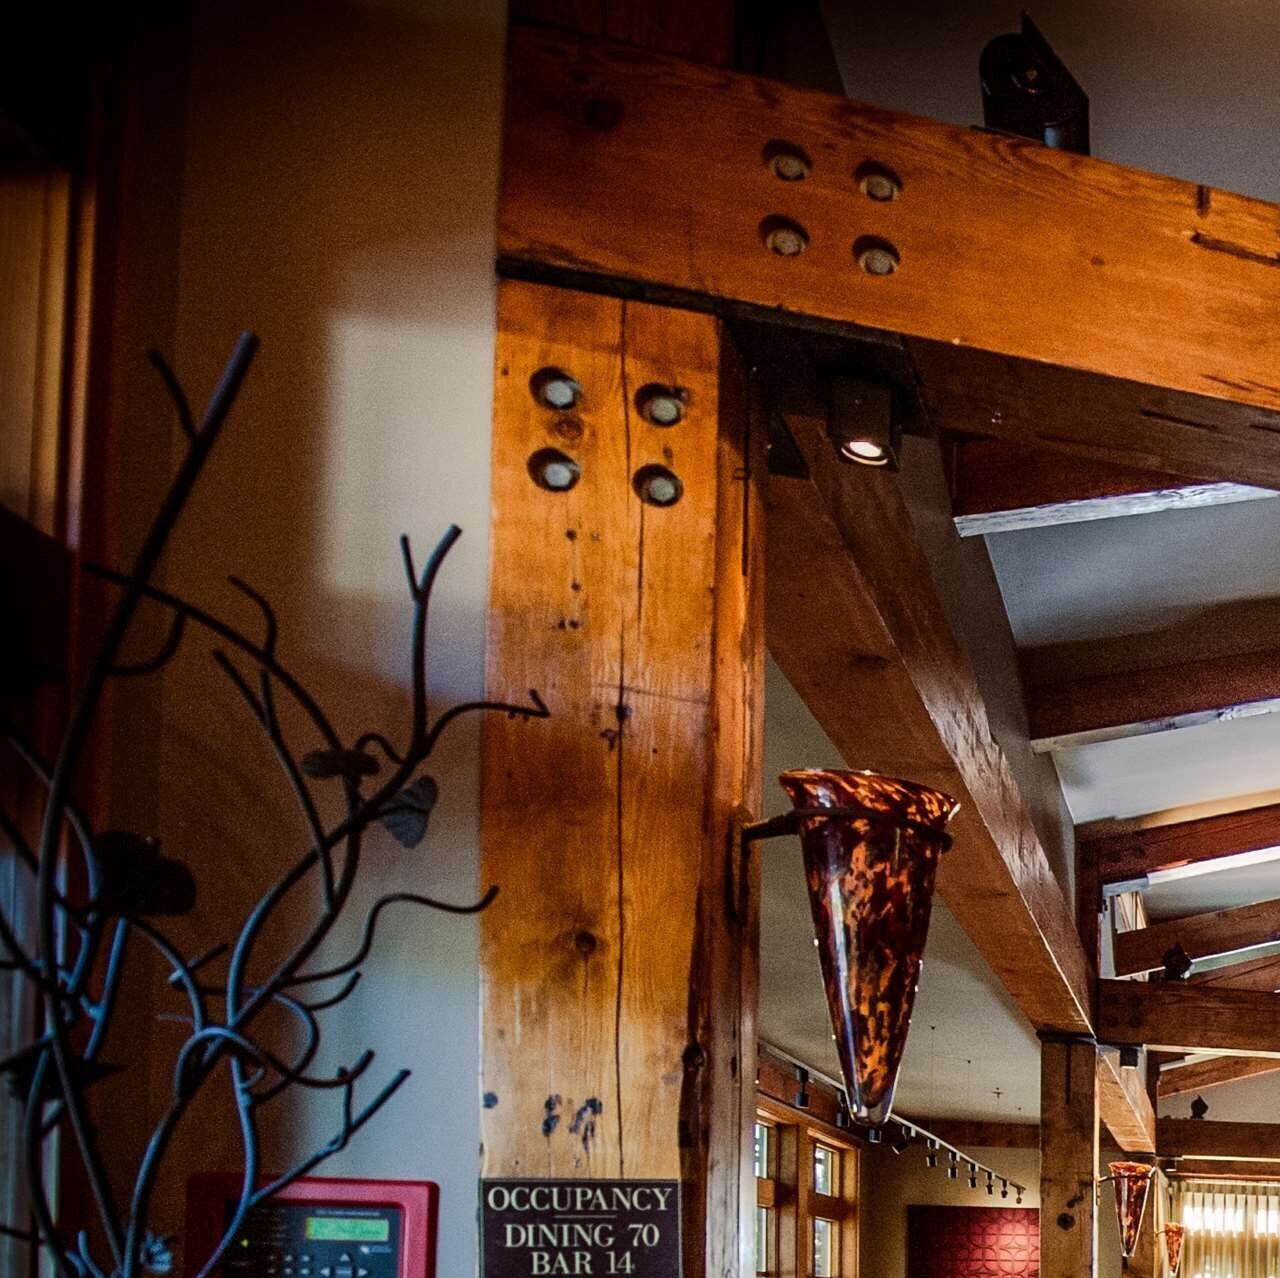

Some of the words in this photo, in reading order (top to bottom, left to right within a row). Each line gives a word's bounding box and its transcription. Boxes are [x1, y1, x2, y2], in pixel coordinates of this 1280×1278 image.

[487, 1186, 672, 1212] OCCUPANCY
[505, 1223, 616, 1248] DINING
[627, 1223, 661, 1248] 70
[531, 1250, 594, 1275] BAR
[605, 1250, 636, 1275] 14
